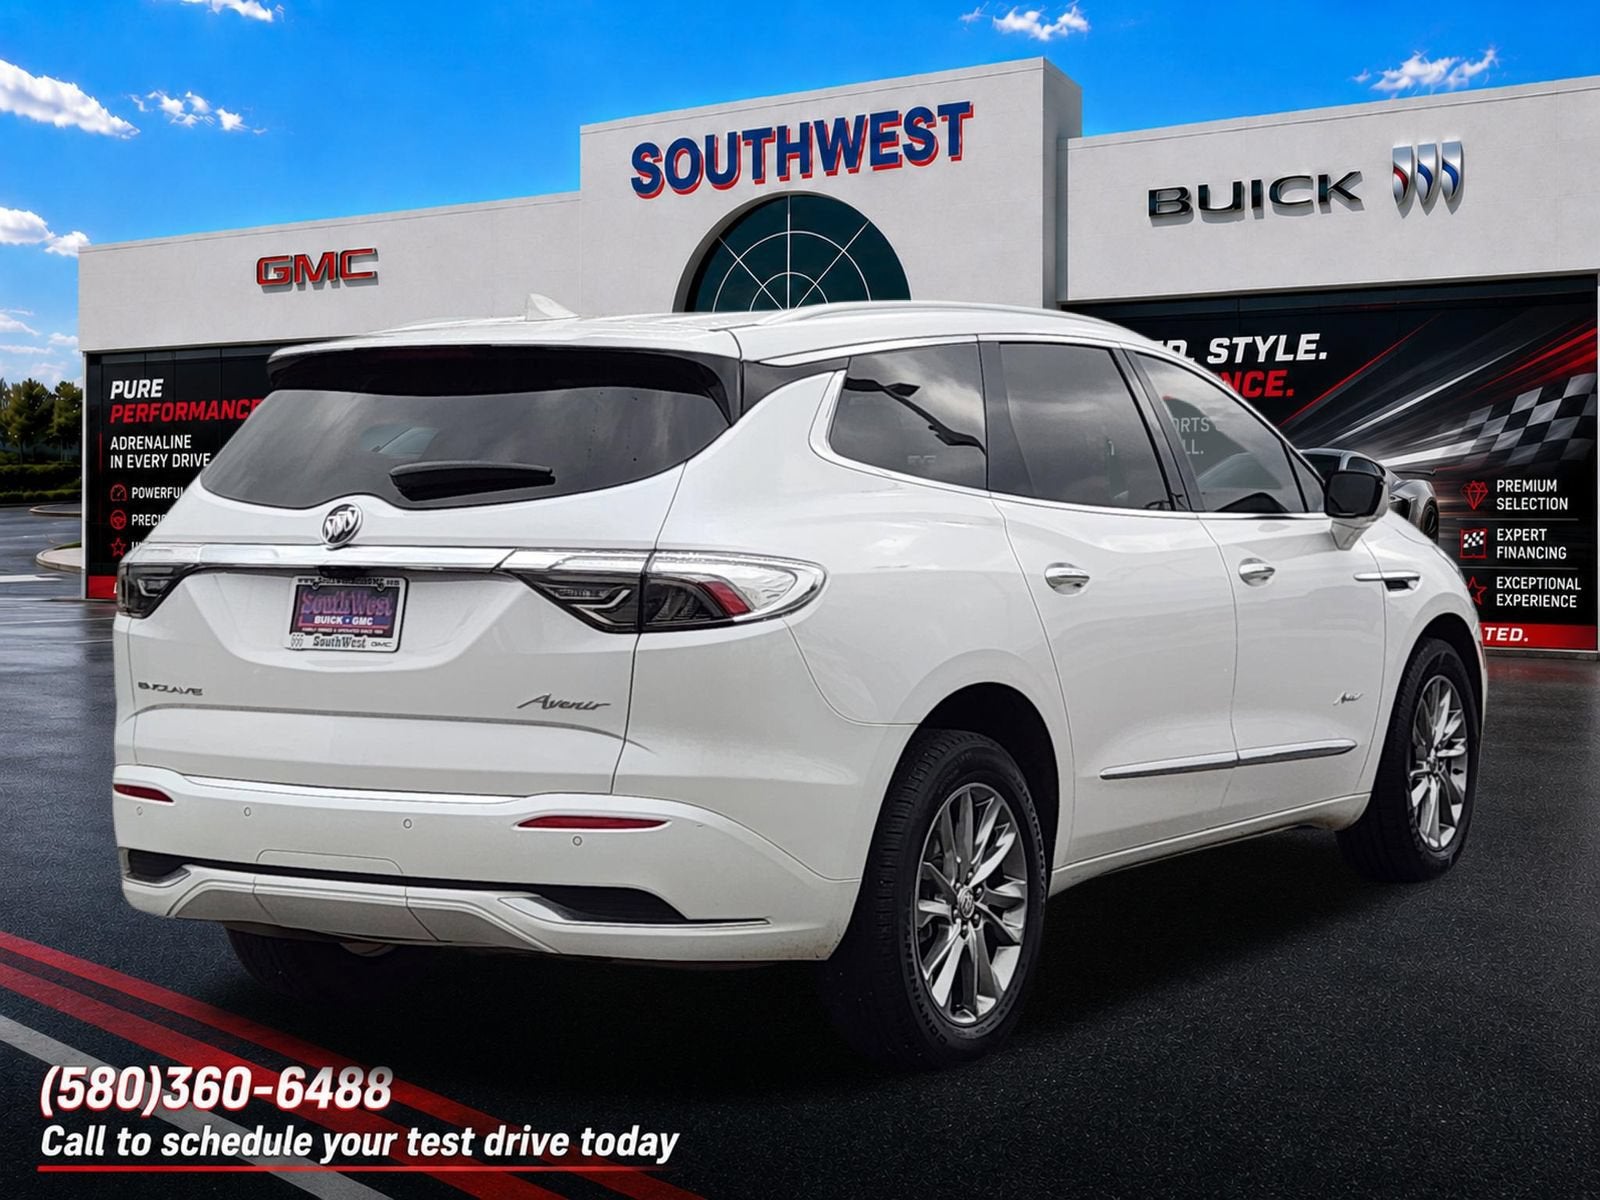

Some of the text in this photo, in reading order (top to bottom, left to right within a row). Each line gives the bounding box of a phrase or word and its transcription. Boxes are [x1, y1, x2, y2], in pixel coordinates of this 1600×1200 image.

[631, 101, 974, 199] SOUTHWEST
[1148, 171, 1364, 224] BUICK
[256, 248, 378, 291] GMC
[1207, 333, 1328, 365] STYLE.
[110, 378, 164, 400] PURE
[110, 434, 192, 450] ADRENALINE
[110, 452, 211, 469] IN EVERY DRIVE
[1496, 479, 1557, 493] PREMIUM
[1496, 497, 1568, 511] SELECTION
[1496, 528, 1547, 541] EXPERT
[1496, 546, 1567, 560] FINANCING
[1496, 576, 1582, 591] EXCEPTIONAL
[1496, 593, 1577, 608] EXPERIENCE
[314, 615, 374, 626] BUICK GMC
[1484, 627, 1529, 642] TED.
[516, 693, 611, 710] Avenir
